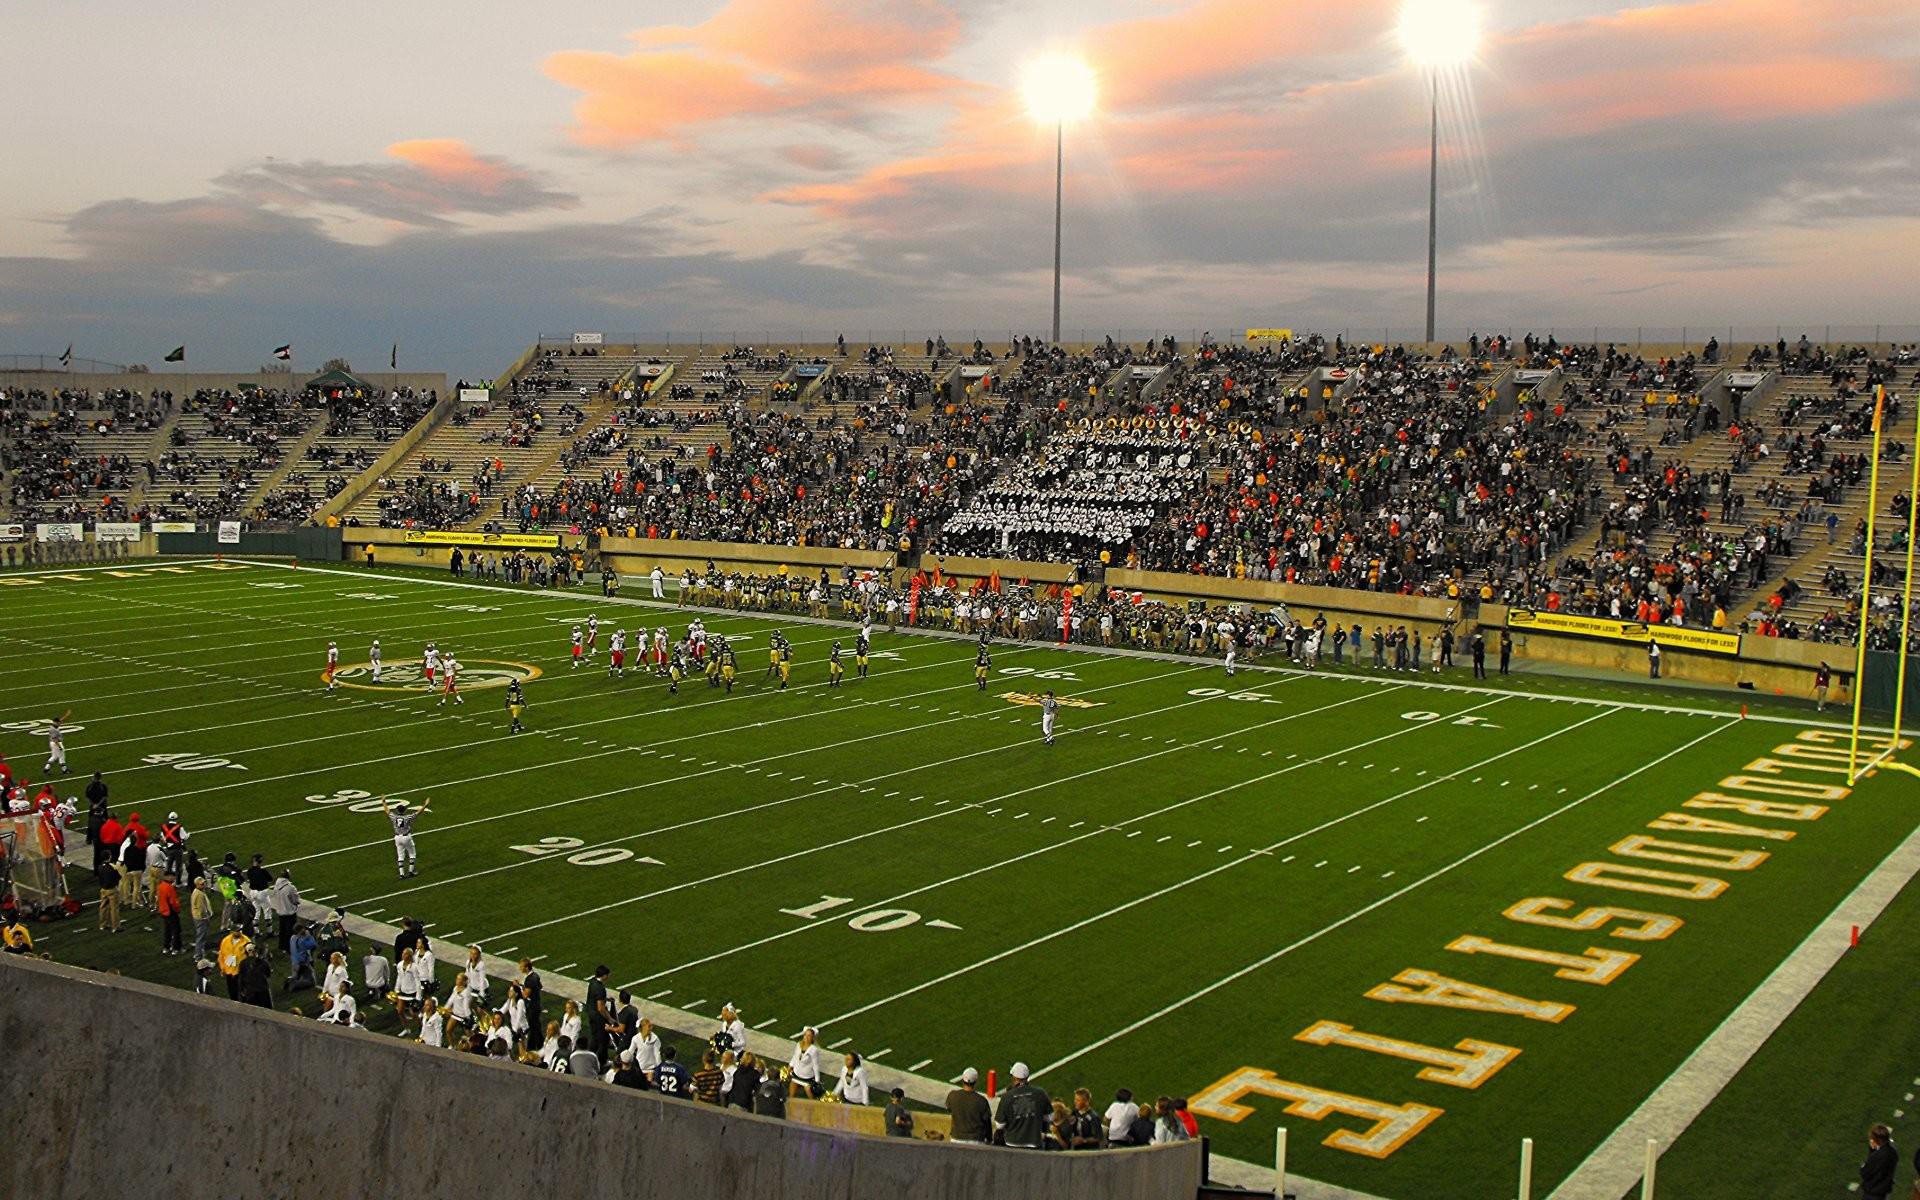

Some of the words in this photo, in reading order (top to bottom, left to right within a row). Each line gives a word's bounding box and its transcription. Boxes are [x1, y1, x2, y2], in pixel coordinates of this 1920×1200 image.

[1650, 631, 1682, 641] HARDWOOD
[1683, 635, 1706, 643] FLOORS
[1707, 638, 1719, 646] FOR
[141, 752, 231, 771] 40
[305, 789, 411, 813] 30
[508, 836, 635, 867] 20
[778, 895, 922, 933] 10
[660, 1075, 677, 1092] 32
